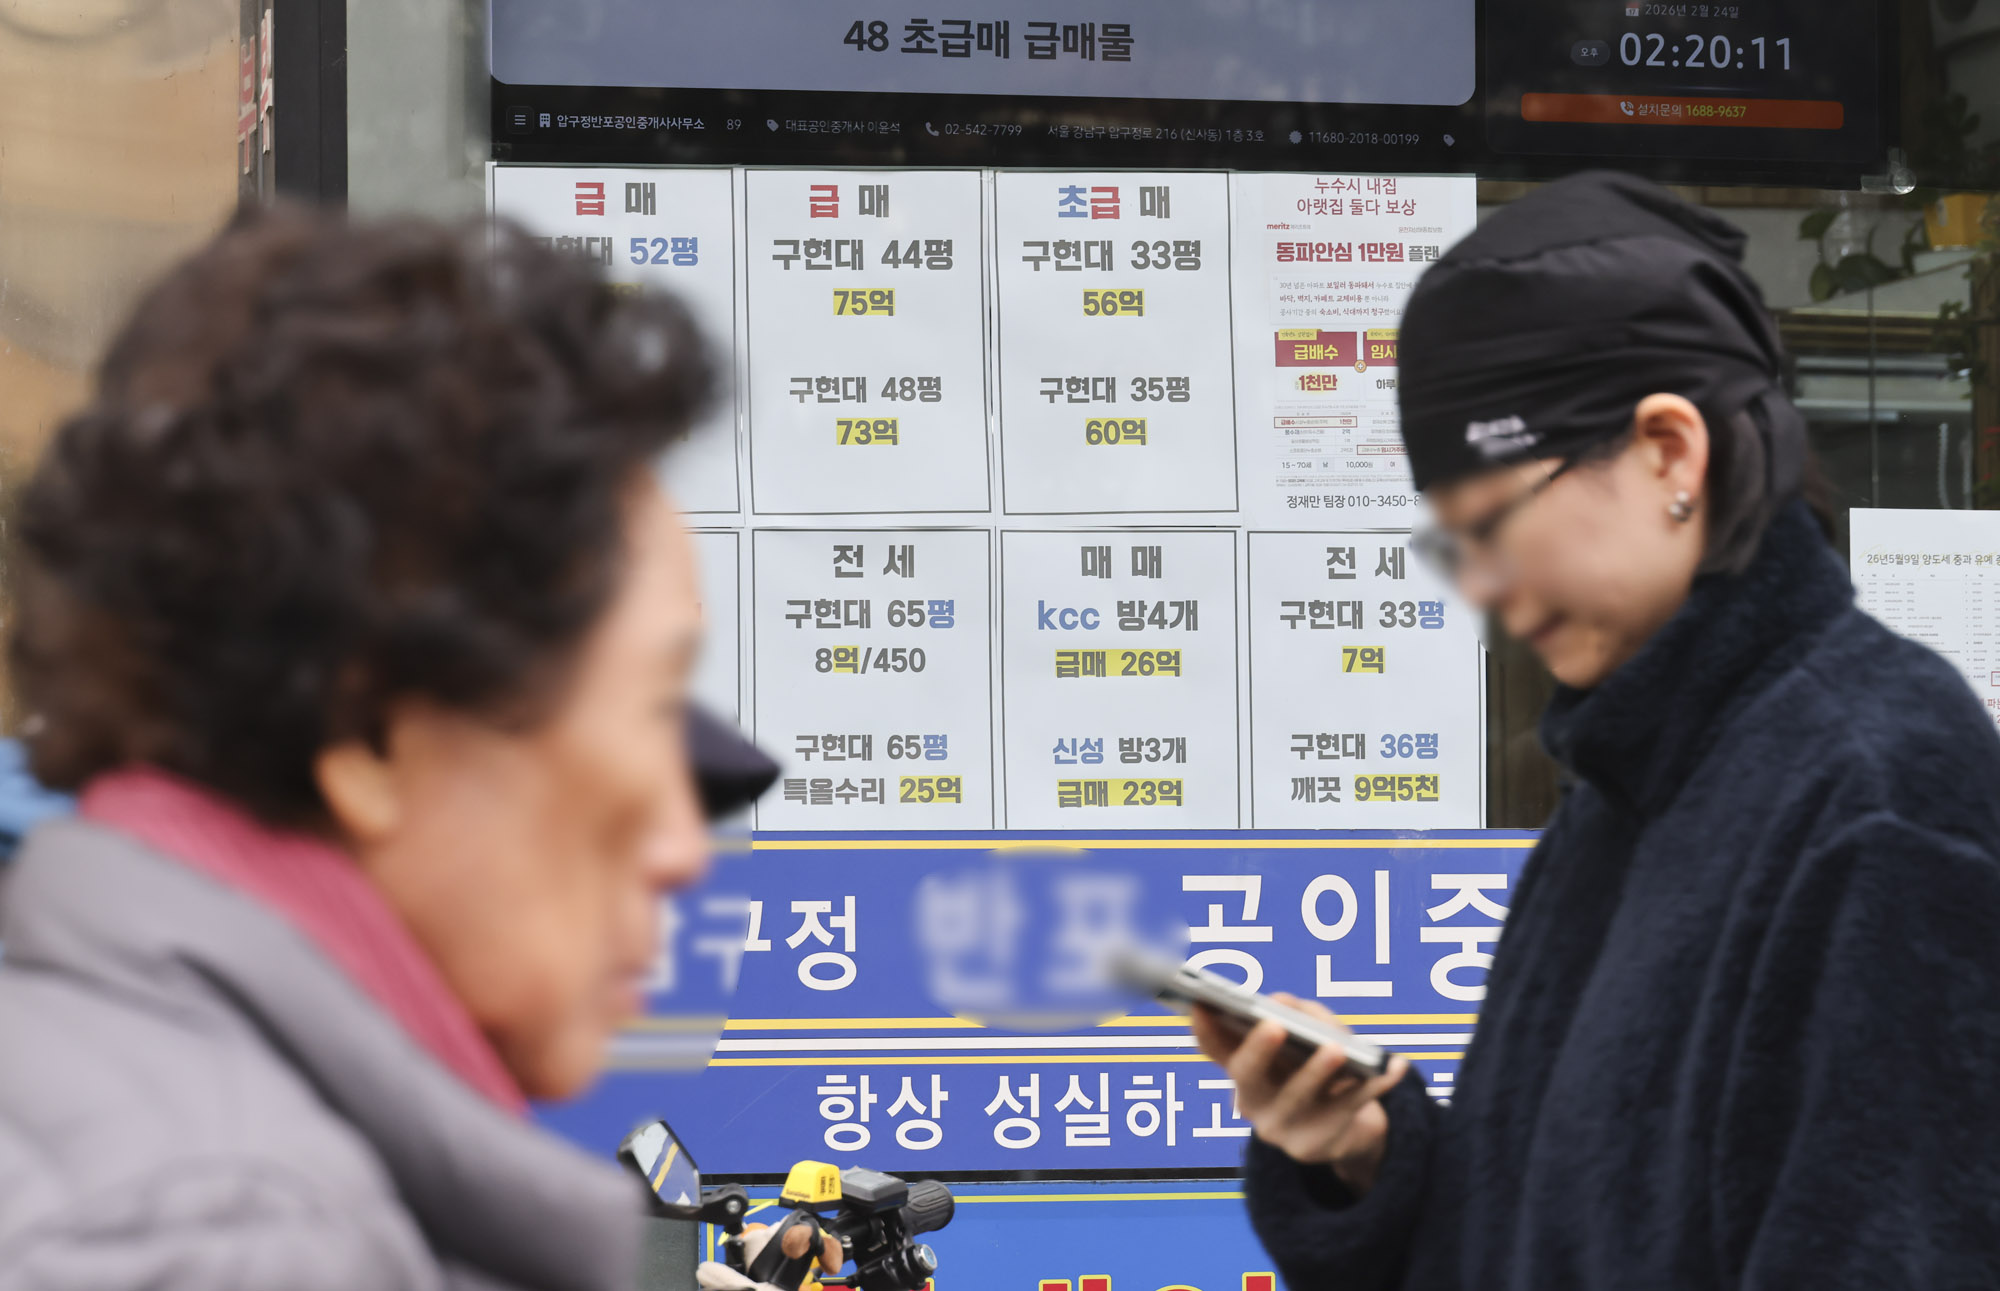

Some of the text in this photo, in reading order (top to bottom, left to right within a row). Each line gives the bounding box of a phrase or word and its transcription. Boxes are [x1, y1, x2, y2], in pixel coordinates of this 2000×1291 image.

[1643, 1, 1738, 18] 2026년 2월 24일
[844, 19, 1134, 61] 48 초급매 급매물
[1581, 33, 1789, 70] 오후 02:20:11
[1638, 104, 1746, 117] 설치문의 1688-9637
[557, 115, 704, 129] 압구정반포공인중개사사무소
[727, 119, 741, 130] 89
[786, 120, 864, 133] 대표공인중개사
[945, 121, 1025, 135] 02-542-7799
[1048, 123, 1072, 137] 서울
[1071, 123, 1105, 138] 강남구
[1109, 124, 1151, 139] 압구정로
[1156, 128, 1177, 139] 216
[1181, 128, 1221, 141] (신사동)
[1226, 129, 1243, 142] 1층
[1246, 130, 1264, 141] 3호
[1309, 132, 1419, 144] 11680-2018-00199
[575, 182, 656, 216] 급 매
[1314, 177, 1397, 196] 누수시 내집
[809, 185, 889, 218] 급 매
[1059, 185, 1170, 219] 초급 매
[1297, 199, 1416, 216] 아랫집 둘다 보상
[1266, 221, 1290, 231] meritz
[631, 237, 698, 266] 52평
[773, 238, 953, 270] 구현대 44평
[1022, 240, 1201, 271] 구현대 33평
[1277, 242, 1440, 263] 동파안심 1만원 플랜
[834, 290, 893, 316] 75억
[1084, 291, 1143, 316] 56억
[1293, 344, 1339, 361] 급배수
[790, 376, 941, 403] 구현대 48평
[1040, 376, 1190, 403] 구현대 35평
[1299, 375, 1337, 391] 1천만
[837, 420, 897, 445] 73억
[1086, 420, 1146, 445] 60억
[1287, 496, 1320, 508] 정재만
[1324, 496, 1345, 508] 팀장
[834, 545, 914, 578] 전 세
[1081, 546, 1161, 578] 매 매
[1327, 547, 1405, 579] 전 세
[1923, 554, 1950, 565] 양도세
[1954, 555, 1971, 565] 중과
[785, 599, 954, 628] 구현대 65평
[1038, 600, 1198, 631] kcc 방4개
[1280, 600, 1444, 629] 구현대 33평
[815, 647, 925, 674] 8억/450
[1056, 651, 1180, 678] 급매 26억
[1343, 648, 1383, 673] 7억
[795, 734, 947, 761] 구현대 65평
[1053, 737, 1186, 764] 신성 방3개
[1291, 733, 1438, 760] 구현대 36평
[783, 776, 961, 805] 특올수리 25억
[1058, 780, 1181, 808] 급매 23억
[1292, 775, 1438, 802] 깨끗 9억5천
[1181, 869, 1512, 1002] 공인중
[816, 1072, 1253, 1152] 항상 성실하고
